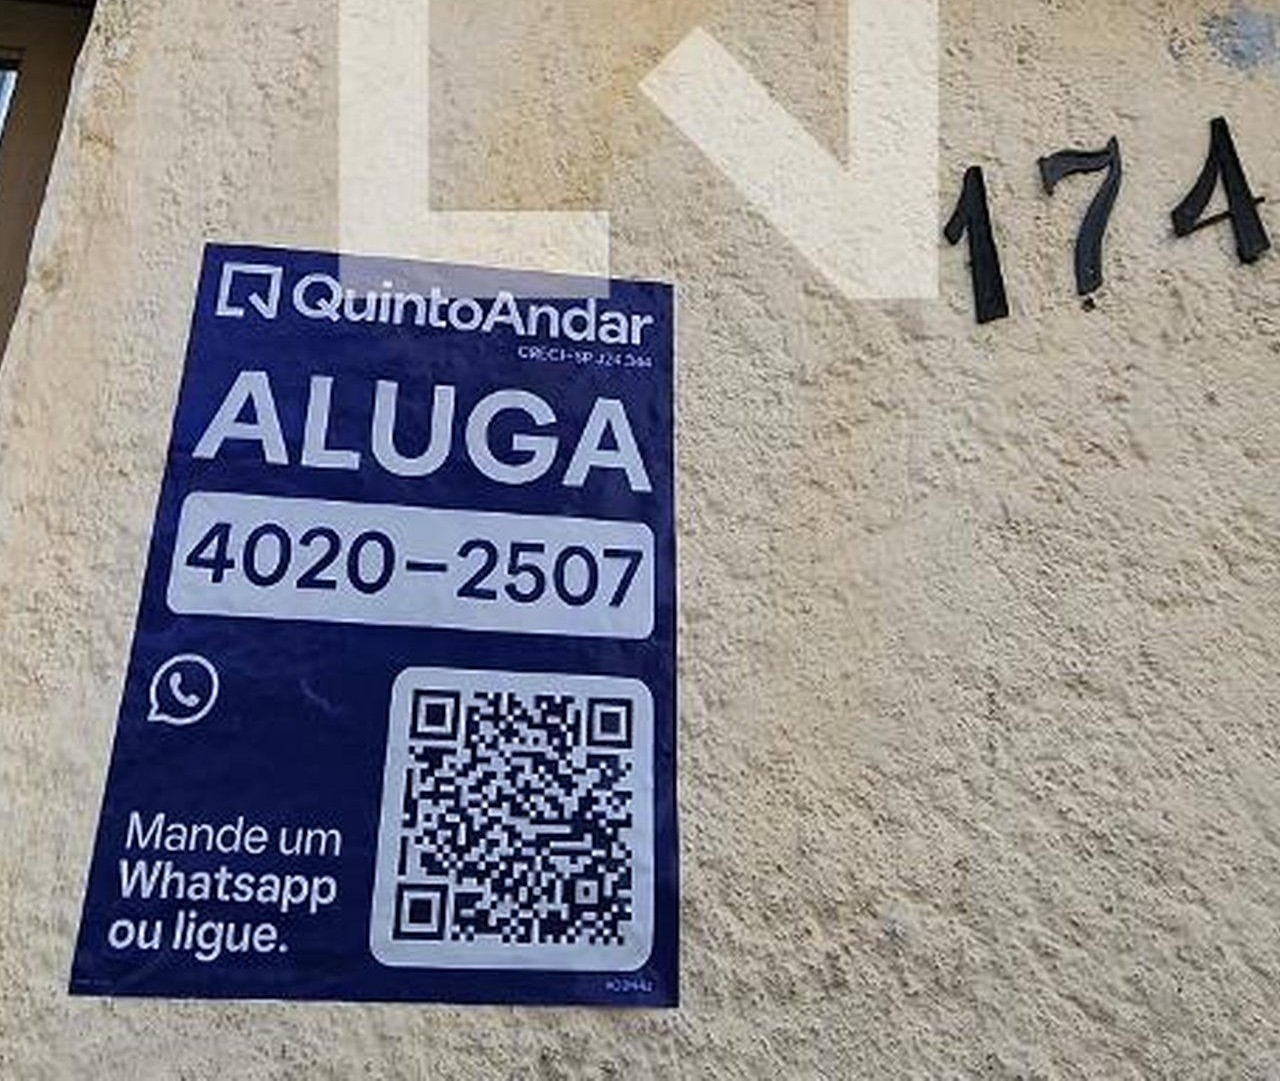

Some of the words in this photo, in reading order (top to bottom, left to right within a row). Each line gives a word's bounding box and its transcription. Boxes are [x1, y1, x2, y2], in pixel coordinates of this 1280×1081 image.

[943, 116, 1271, 324] 174
[292, 273, 653, 346] QuintoAndar
[191, 370, 653, 493] ALUGA
[186, 522, 645, 608] 4020-2507
[125, 811, 269, 855] Mande
[279, 827, 342, 857] um
[119, 858, 338, 914] Whatsapp
[107, 918, 162, 950] ou
[172, 909, 289, 961] ligue.
